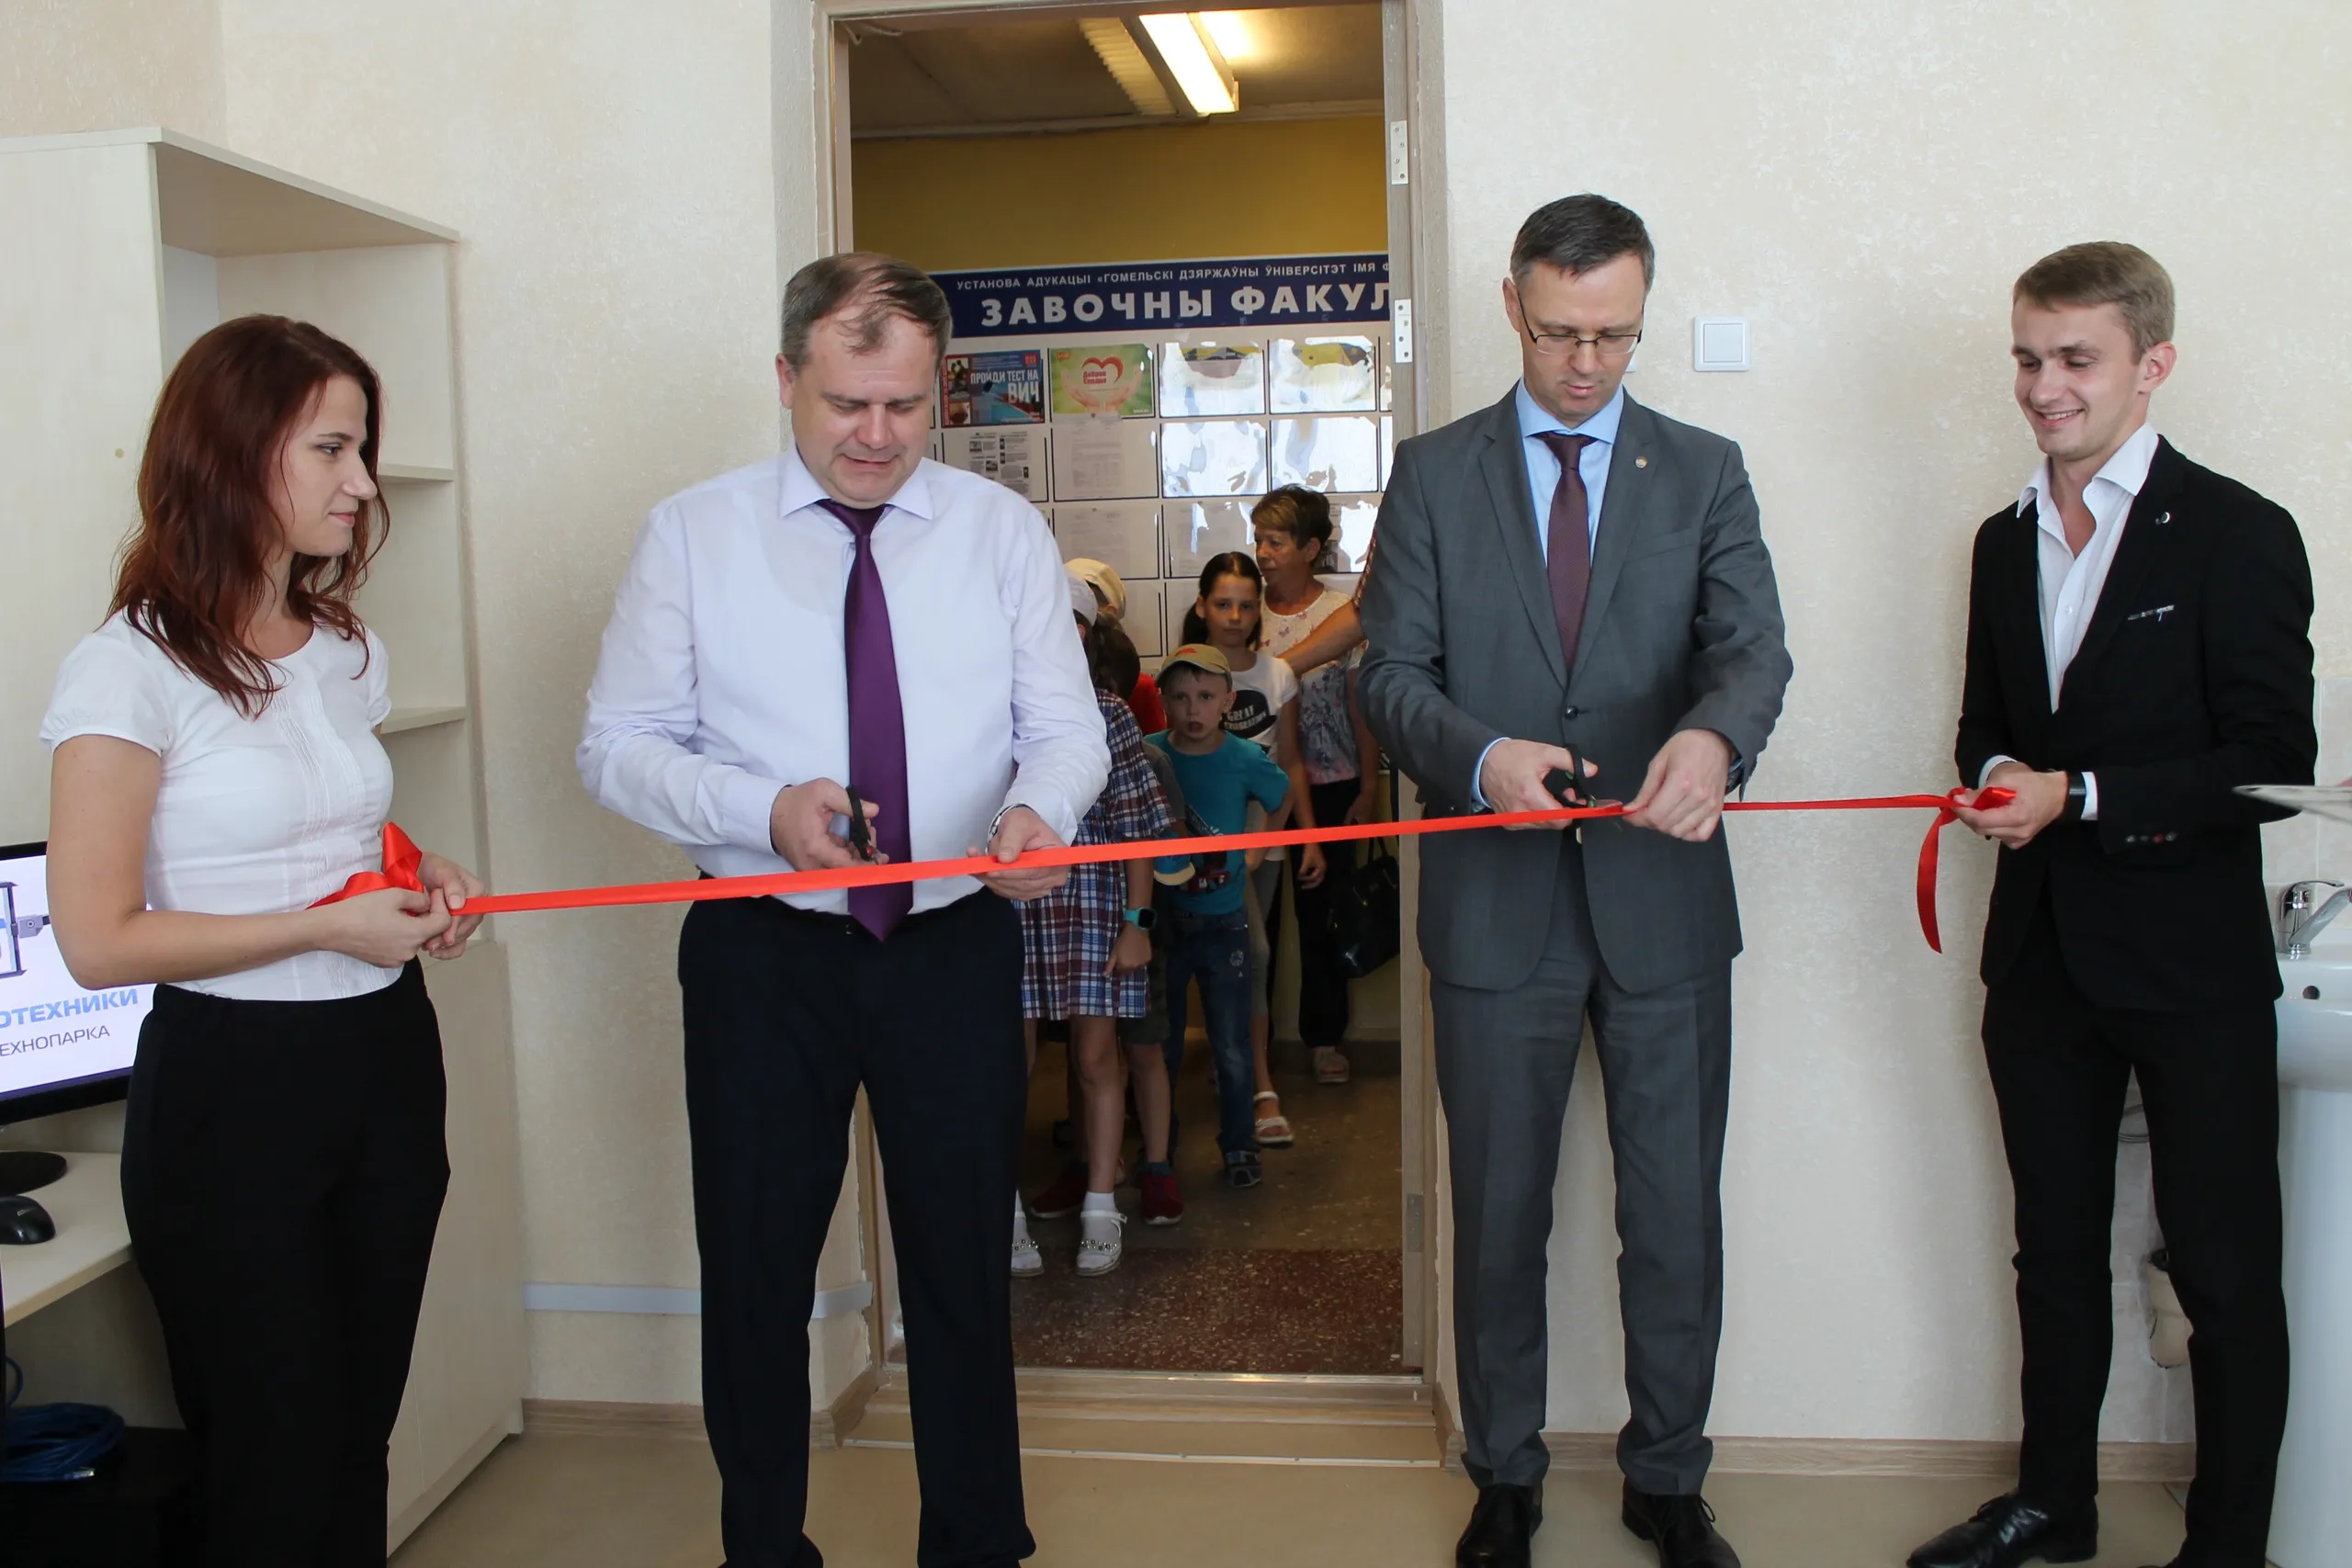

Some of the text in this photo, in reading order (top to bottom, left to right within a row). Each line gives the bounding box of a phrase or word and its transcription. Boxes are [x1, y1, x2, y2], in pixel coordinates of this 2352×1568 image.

[957, 279, 1021, 290] УСТАНОВА
[1026, 275, 1091, 288] АДУКАЦЫІ
[1180, 266, 1259, 281] ДЗЯРЖАЎНЫ
[1265, 263, 1347, 276] ЎНІВЕРСІТЭТ
[1353, 263, 1375, 273] ІМЯ
[981, 289, 1212, 327] ЗАВОЧНЫ
[970, 367, 1038, 384] ПРОЙДИ ТЕСТ НА
[1007, 381, 1040, 404] ВИЧ
[0, 1025, 110, 1056] ЕХНОПАРКА
